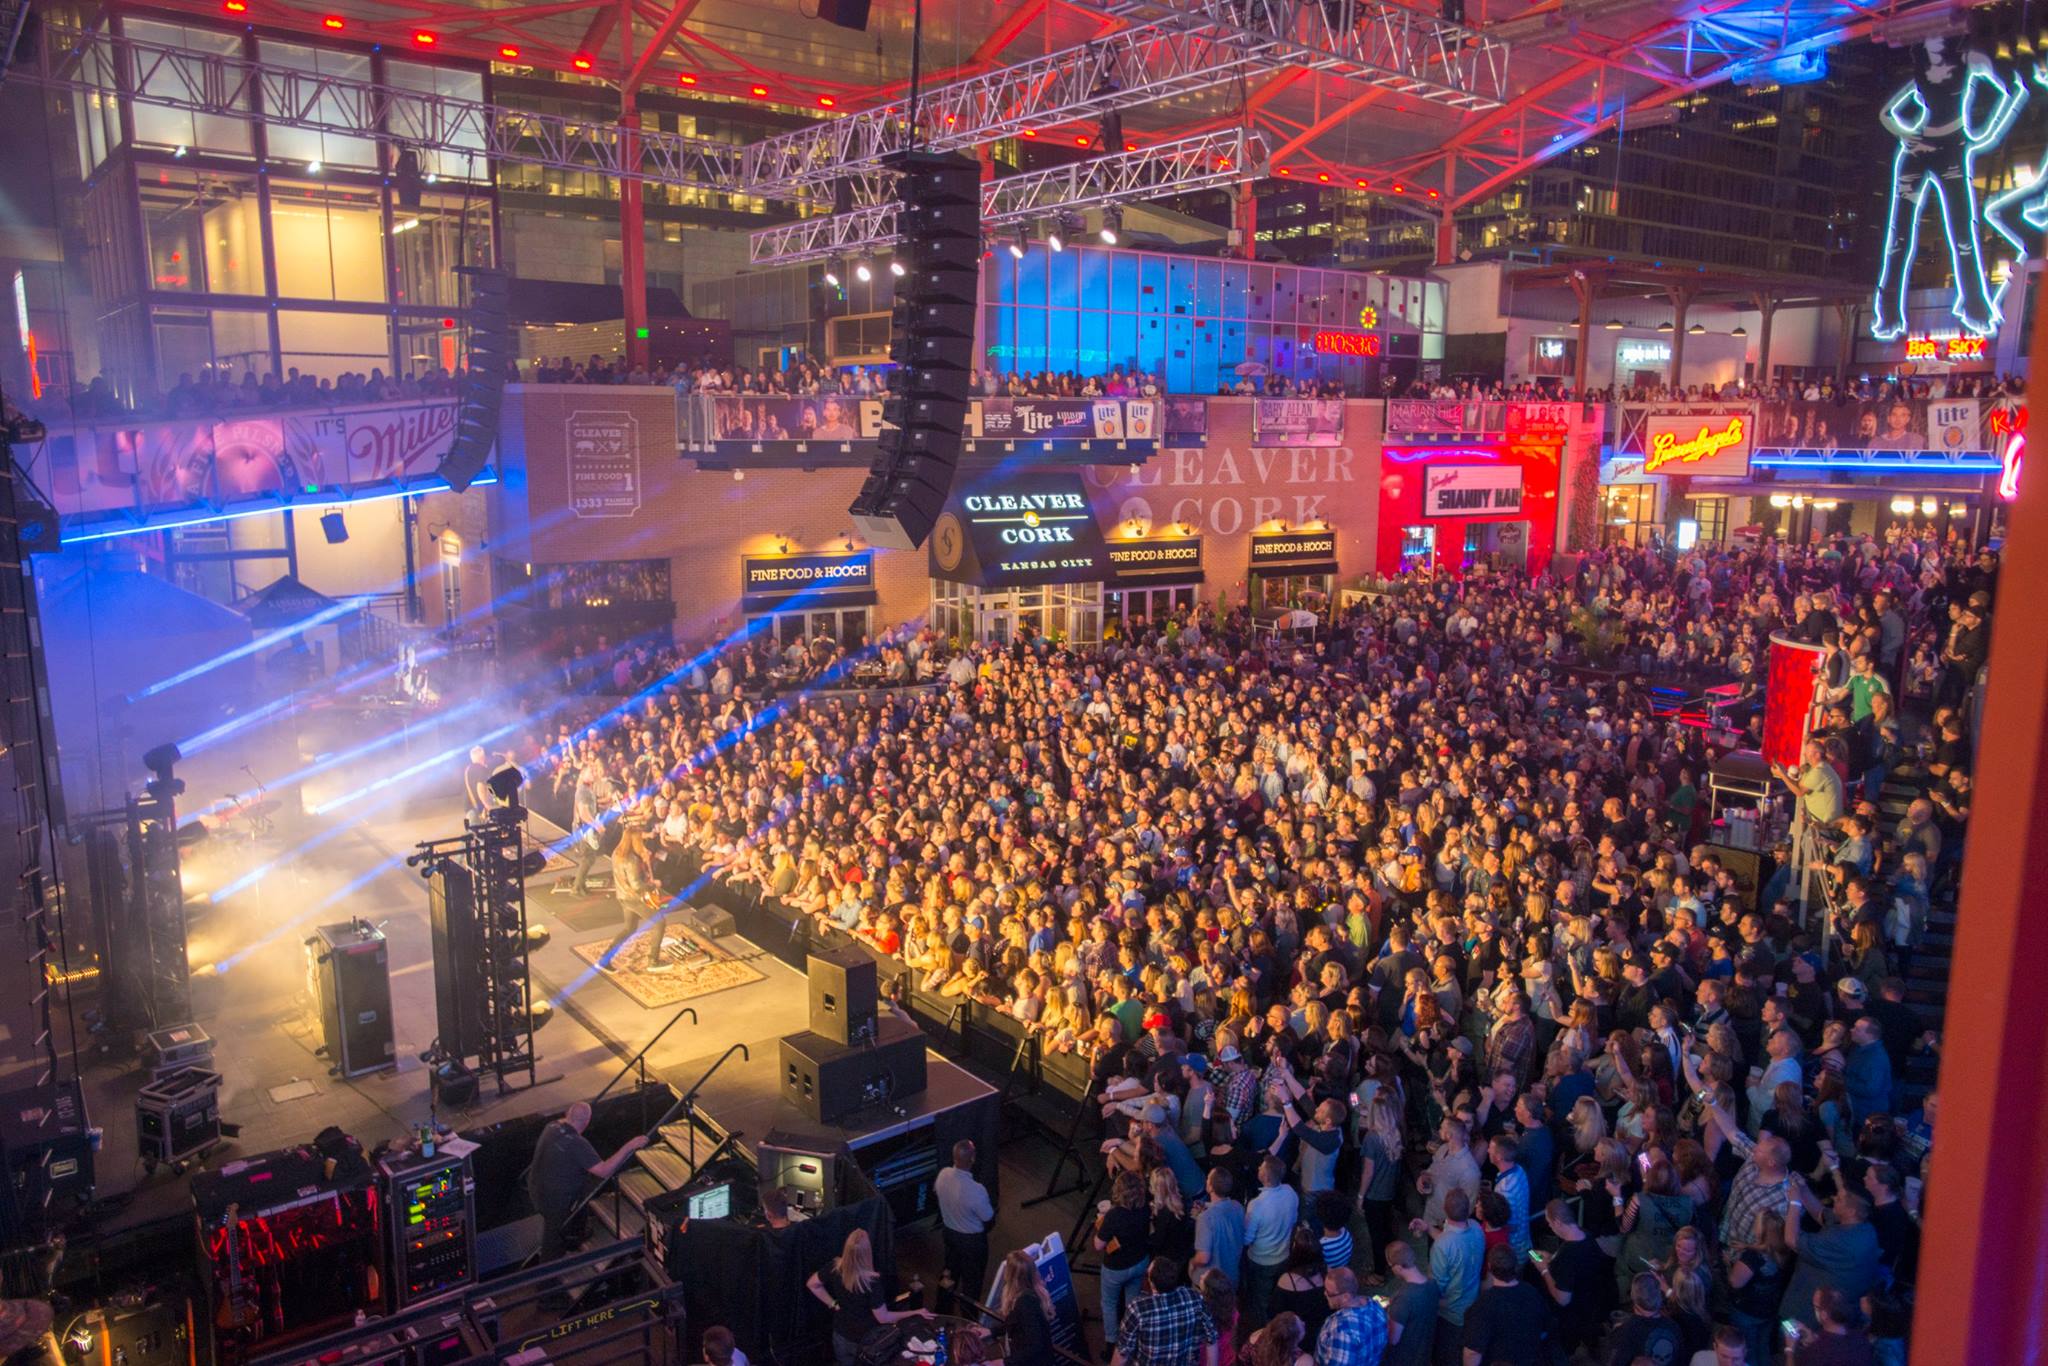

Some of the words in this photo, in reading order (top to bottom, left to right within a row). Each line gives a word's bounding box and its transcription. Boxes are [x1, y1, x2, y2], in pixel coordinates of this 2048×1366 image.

[1948, 337, 1984, 354] SKY
[1286, 402, 1312, 417] ALLAN
[1936, 407, 1969, 427] Lite
[314, 417, 346, 437] IT'S
[1023, 411, 1053, 434] Lite
[598, 472, 623, 481] FOOD
[575, 498, 602, 508] 1333
[966, 494, 1085, 512] CLEAVER
[1437, 488, 1492, 510] SHANDY
[1171, 495, 1326, 537] CORK
[1002, 526, 1074, 545] CORK
[1109, 551, 1130, 562] FINE
[1131, 550, 1156, 561] FOOD
[1157, 550, 1164, 560] &
[1165, 548, 1197, 560] HOOCH
[1254, 544, 1273, 554] FINE
[1274, 543, 1296, 553] FOOD
[1296, 542, 1304, 552] &
[1303, 541, 1332, 552] HOOCH
[751, 569, 778, 581] FINE
[780, 567, 813, 580] FOOD
[814, 567, 823, 578] &
[824, 565, 867, 577] HOOCH
[1001, 560, 1057, 571] KANSAS
[1061, 558, 1093, 568] CITY
[551, 1319, 582, 1339] LIFT
[586, 1308, 615, 1327] HERE
